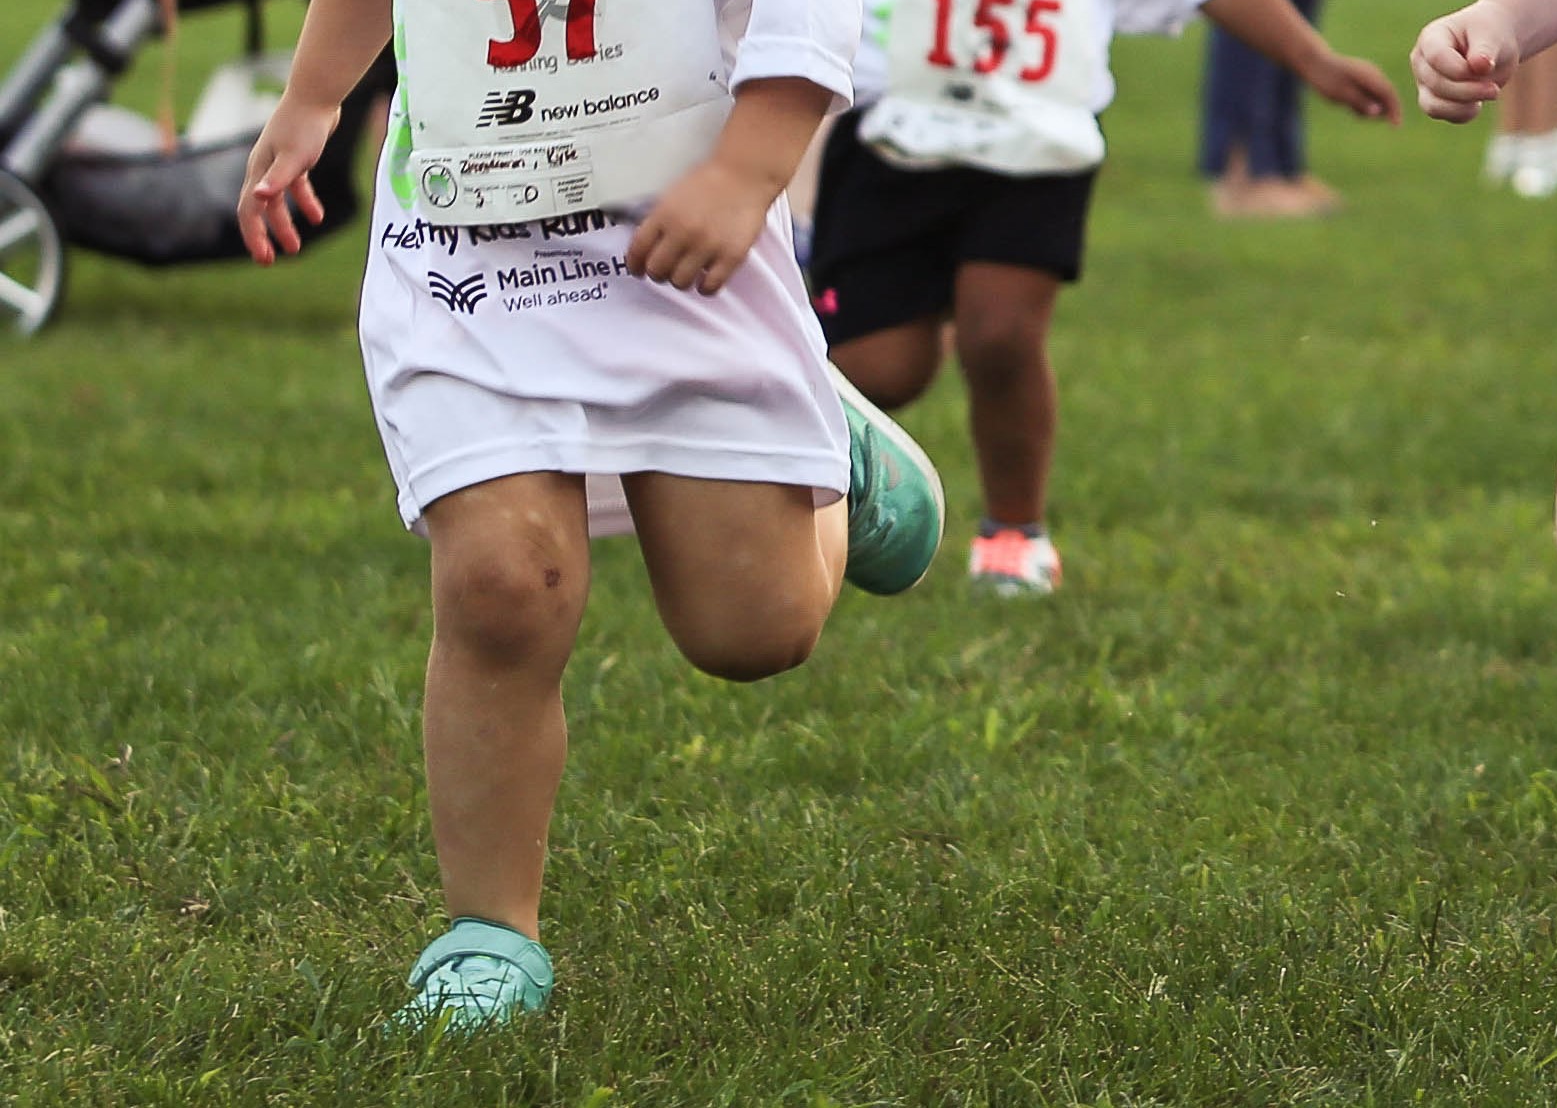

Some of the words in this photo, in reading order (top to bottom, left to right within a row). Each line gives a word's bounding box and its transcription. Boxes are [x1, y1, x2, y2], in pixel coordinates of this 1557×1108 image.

[541, 102, 579, 123] new
[584, 87, 659, 115] balance
[497, 264, 557, 290] Main
[559, 256, 611, 281] Line
[503, 296, 542, 312] Well
